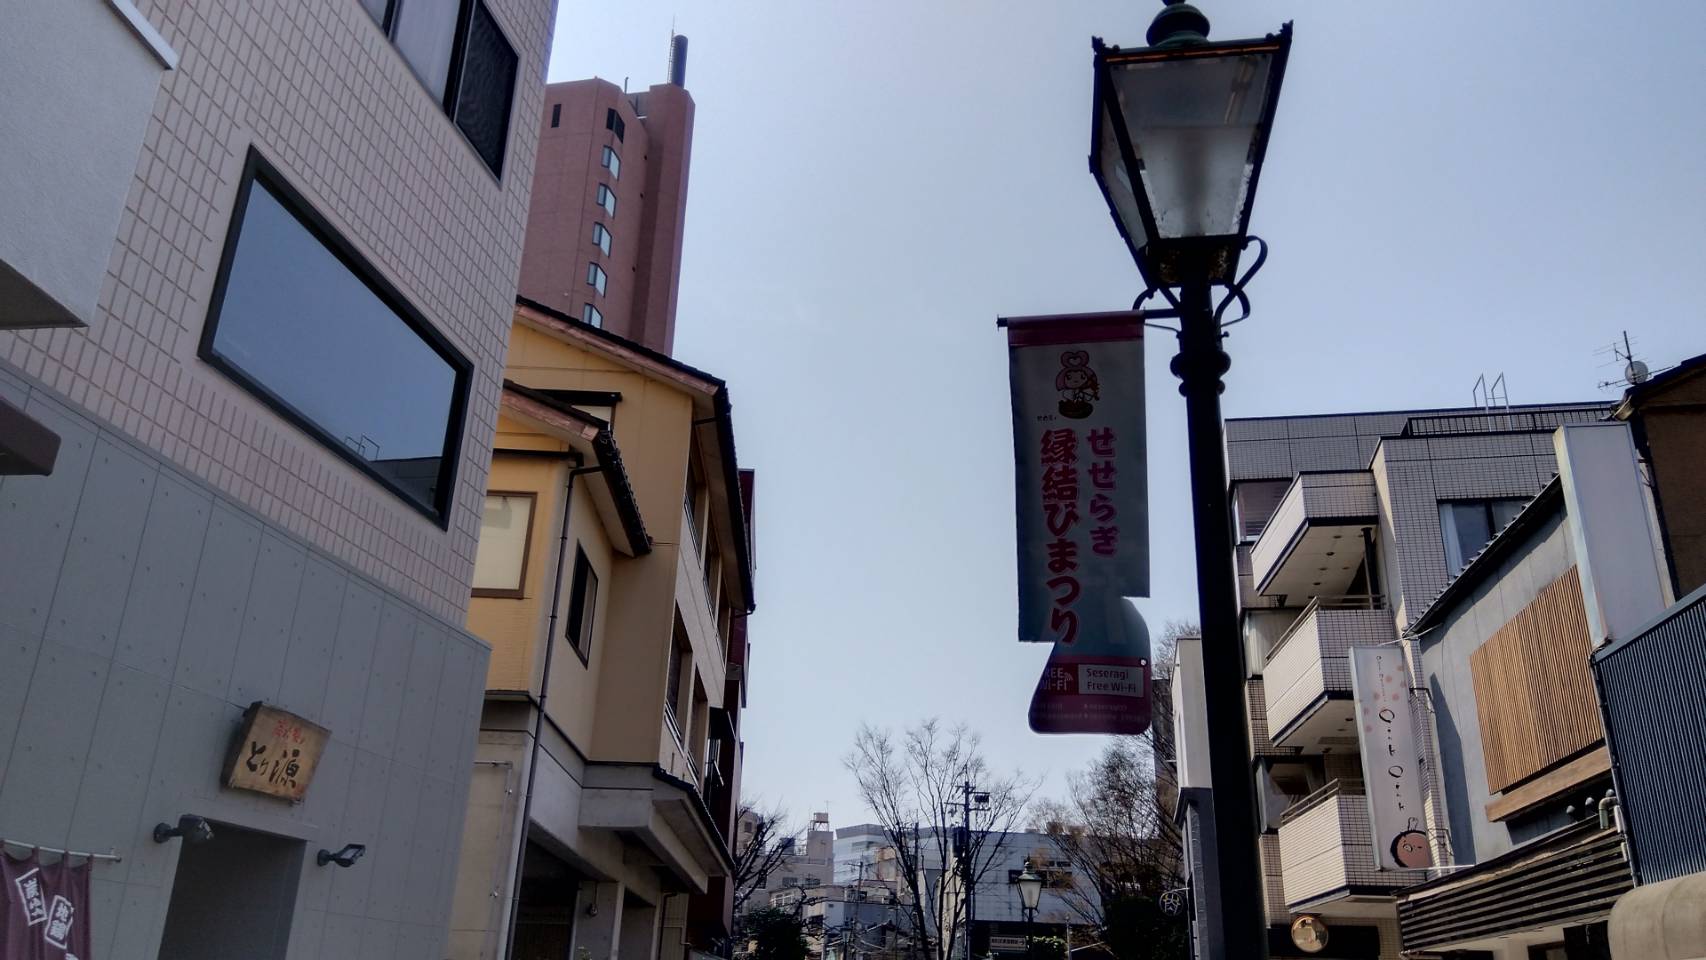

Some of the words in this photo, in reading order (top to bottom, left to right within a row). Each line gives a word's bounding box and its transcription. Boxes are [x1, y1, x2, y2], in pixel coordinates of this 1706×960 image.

[1086, 427, 1118, 555] せせらぎ
[1041, 428, 1080, 643] 縁結びまつり
[1086, 668, 1129, 680] Seseragi
[1087, 681, 1109, 691] Free
[1111, 682, 1136, 693] Wi-Fi
